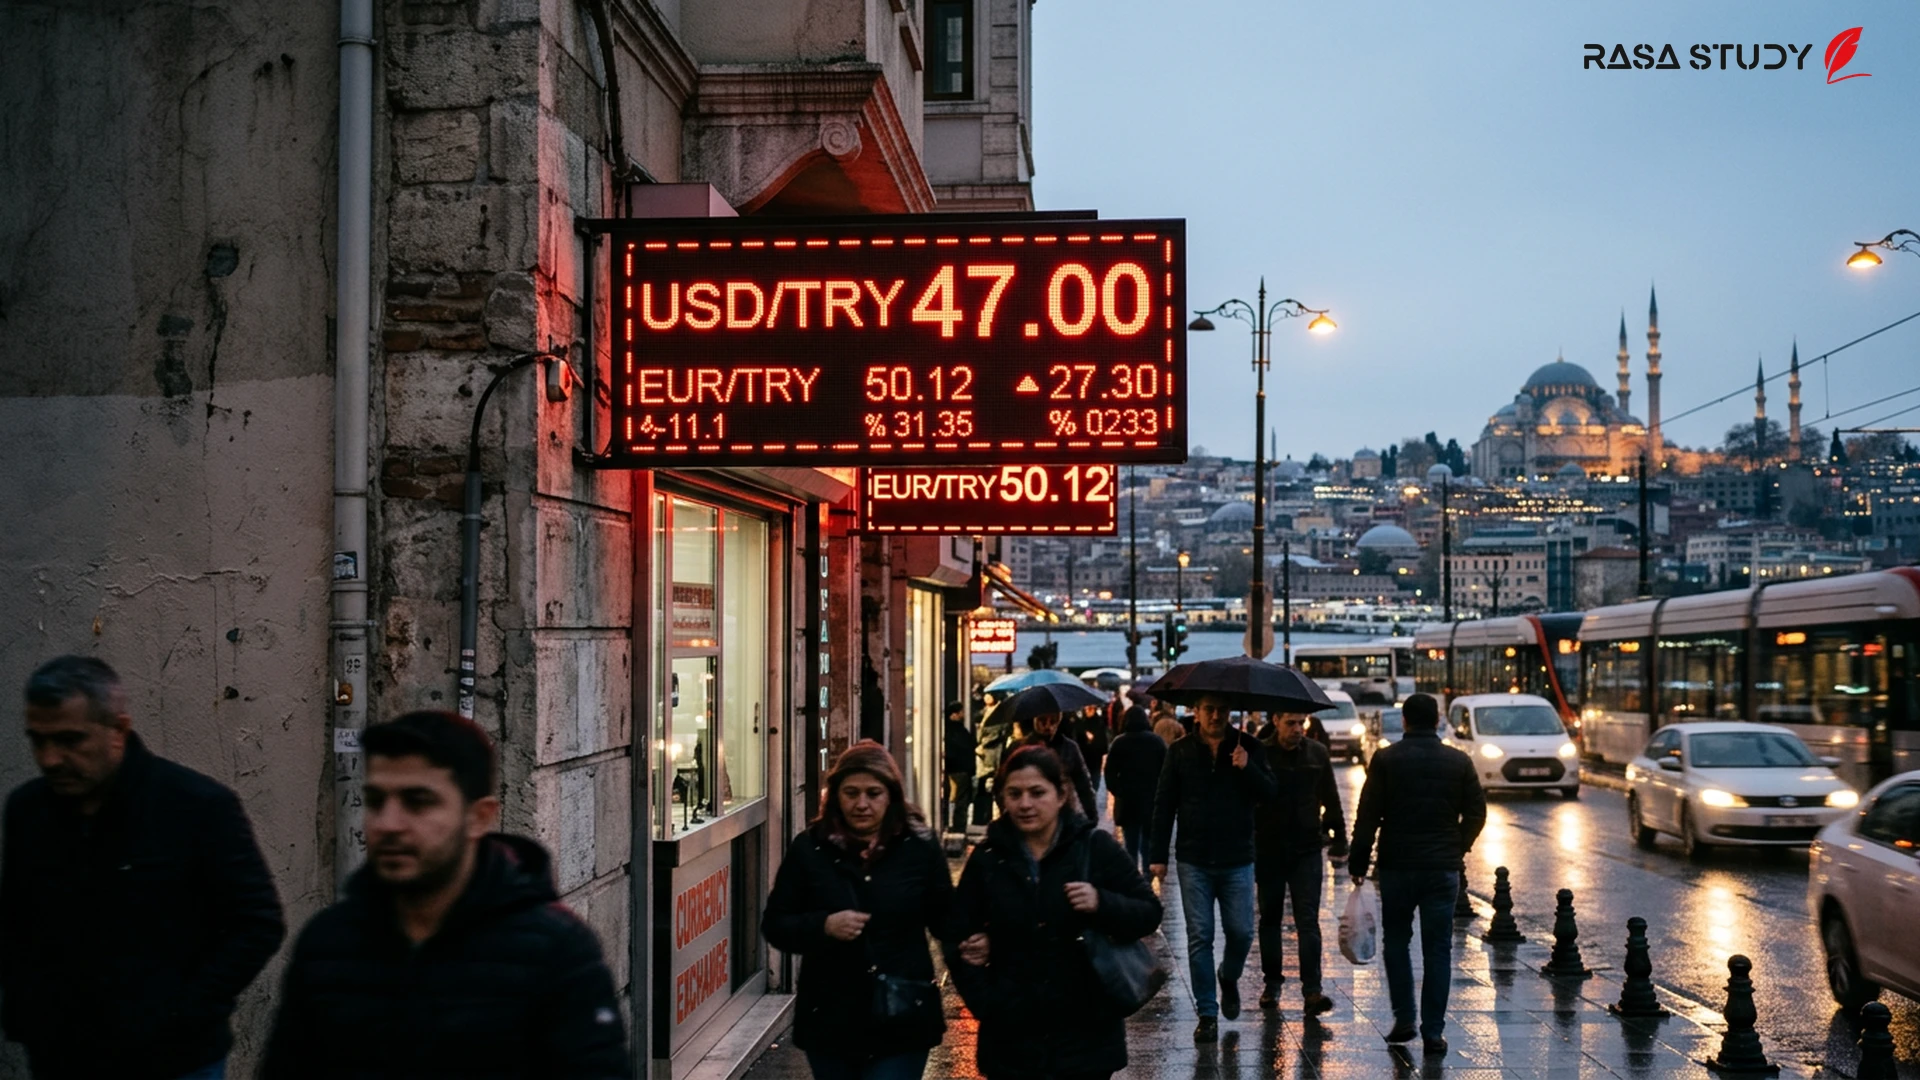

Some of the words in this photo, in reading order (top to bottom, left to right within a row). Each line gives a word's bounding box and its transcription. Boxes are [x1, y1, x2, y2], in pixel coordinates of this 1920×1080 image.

[643, 279, 905, 330] USD/TRY
[912, 262, 1150, 337] 47.00
[640, 367, 820, 404] EUR/TRY
[866, 366, 972, 401] 50.12
[1049, 364, 1157, 399] 27.30
[894, 410, 973, 437] 31.35
[1086, 408, 1158, 436] 0233
[872, 474, 998, 500] EUR/TRY
[1000, 465, 1110, 502] 50.12
[676, 865, 729, 951] CURRENCY
[676, 936, 728, 1025] EXCHANGE
